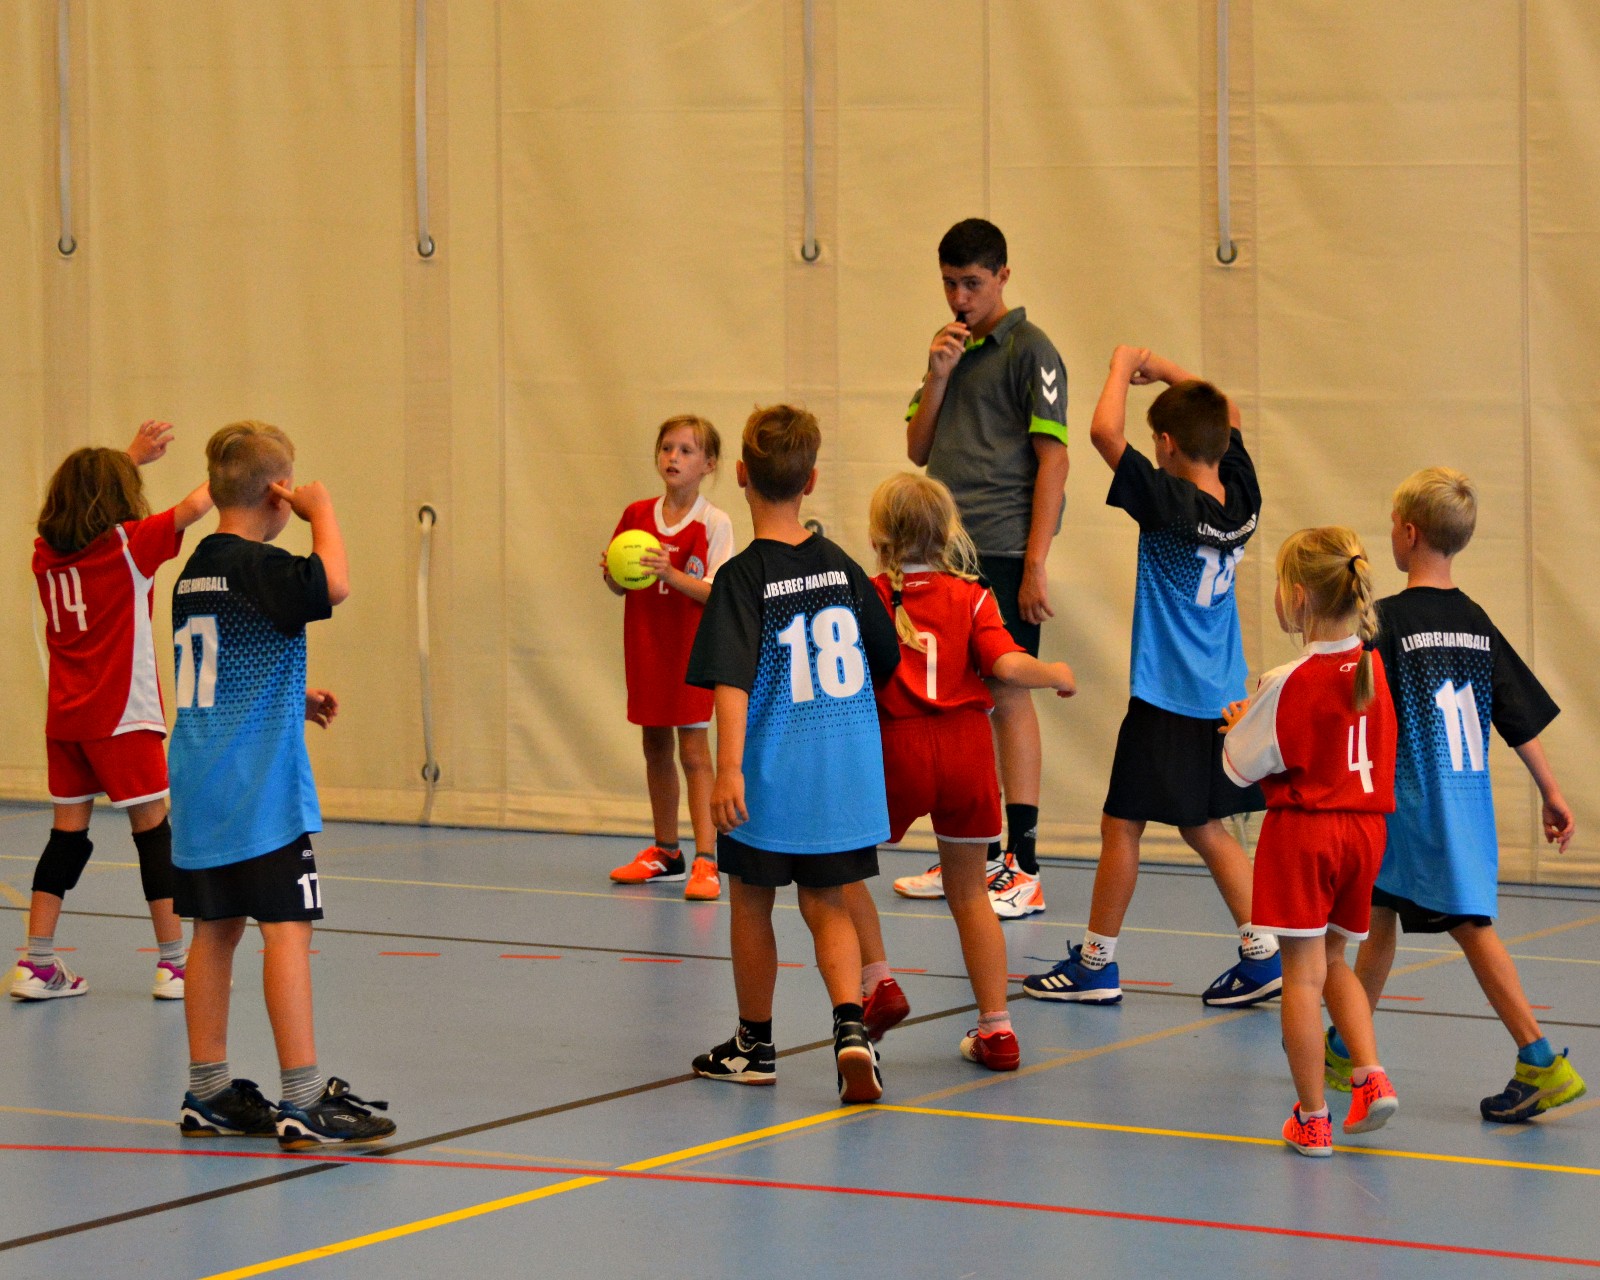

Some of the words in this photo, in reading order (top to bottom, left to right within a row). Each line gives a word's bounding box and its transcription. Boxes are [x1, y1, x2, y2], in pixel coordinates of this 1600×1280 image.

[46, 567, 88, 632] 14
[763, 577, 804, 599] LIBEREC
[778, 607, 864, 703] 18
[1443, 632, 1490, 651] HANDBALL
[1348, 715, 1373, 793] 4
[1435, 680, 1484, 771] 11
